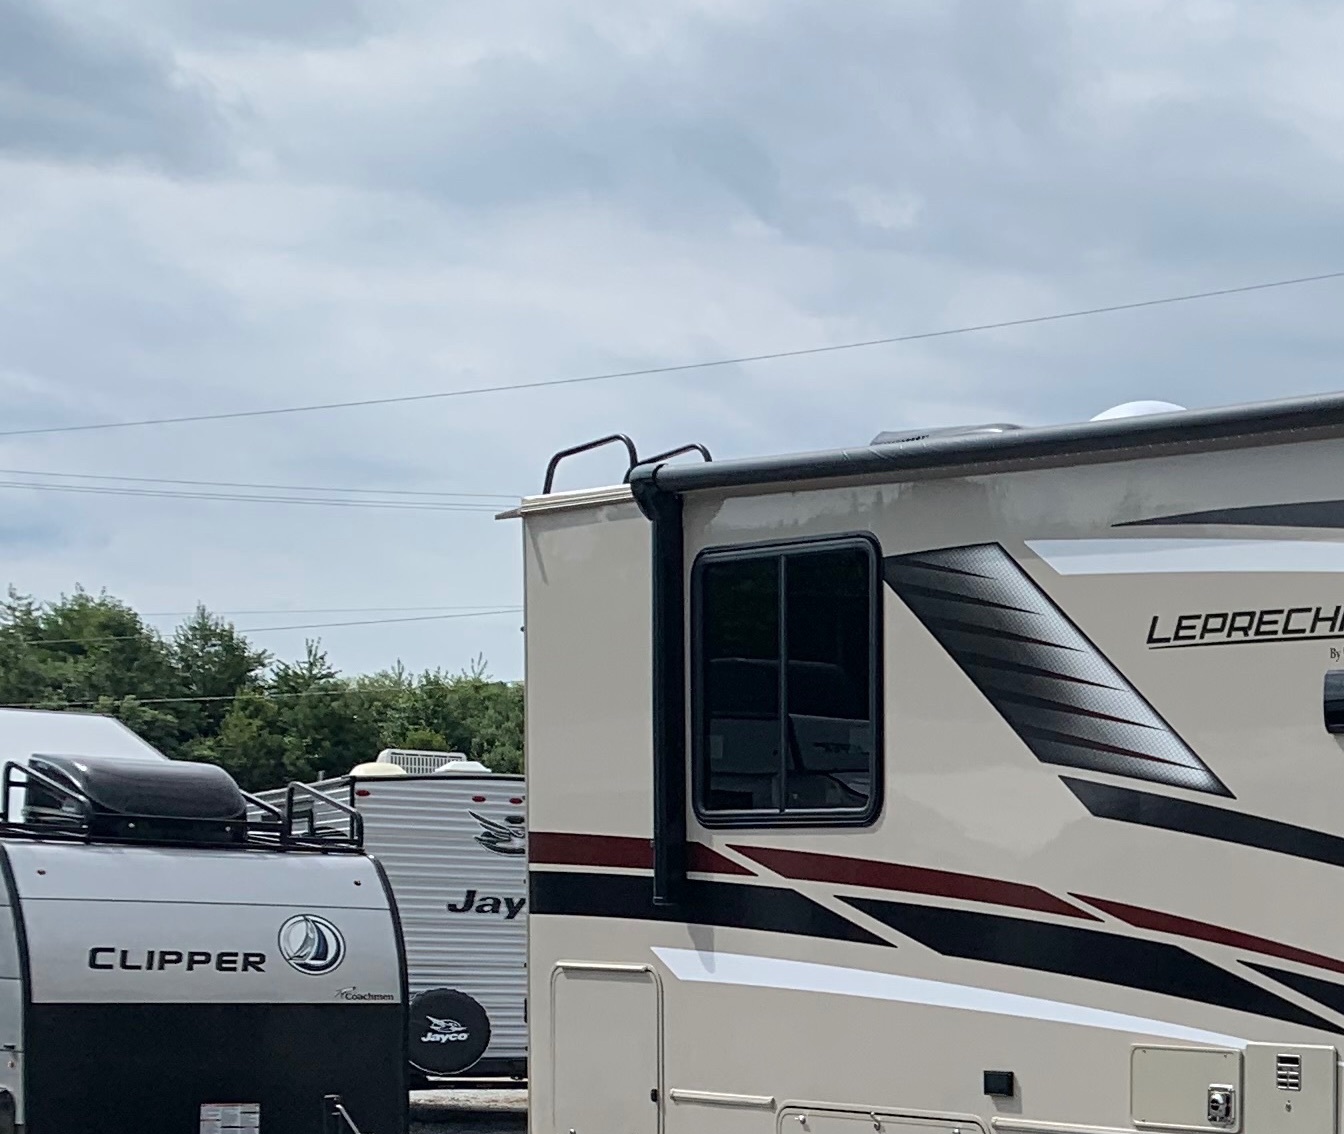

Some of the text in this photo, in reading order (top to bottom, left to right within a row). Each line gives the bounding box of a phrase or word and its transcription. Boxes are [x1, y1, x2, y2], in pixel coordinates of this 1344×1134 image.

[1330, 648, 1341, 662] By
[447, 889, 526, 920] Jay
[88, 947, 266, 972] CLIPPER
[344, 992, 394, 1001] Coachmen
[421, 1031, 468, 1043] Jayco
